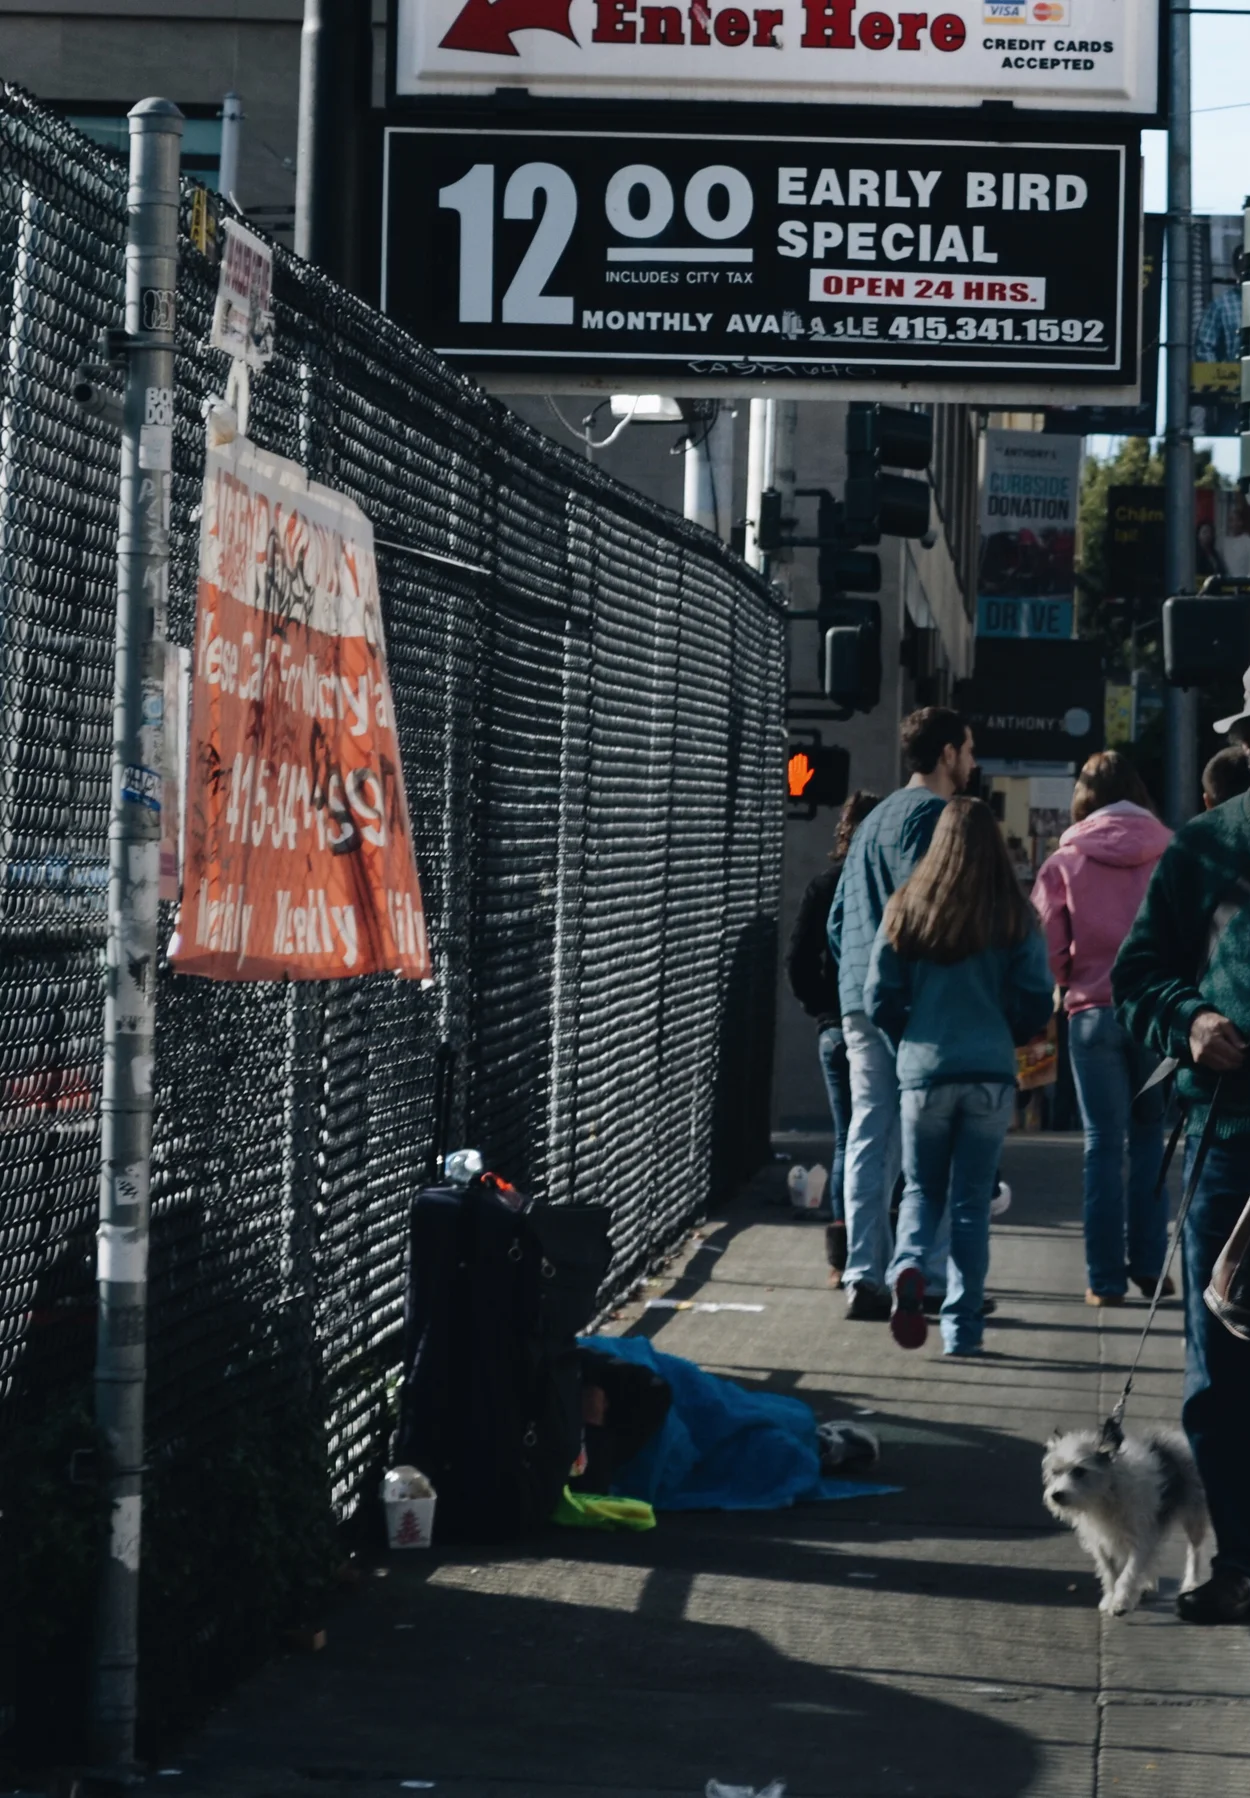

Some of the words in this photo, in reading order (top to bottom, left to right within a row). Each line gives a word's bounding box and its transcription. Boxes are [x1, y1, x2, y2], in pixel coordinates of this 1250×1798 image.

[990, 5, 1020, 17] VISA
[592, 0, 784, 48] Enter
[801, 0, 966, 52] Here
[982, 37, 1046, 52] CREDIT
[1053, 39, 1114, 53] CARDS
[1001, 56, 1095, 71] ACCEPTED
[778, 167, 943, 208] EARLY
[966, 171, 1088, 211] BIRD
[438, 162, 578, 325] 12
[777, 220, 998, 264] SPECIAL
[605, 271, 679, 284] INCLUDES
[686, 271, 720, 284] CITY
[726, 272, 753, 284] TAX
[822, 275, 904, 297] OPEN
[914, 279, 955, 299] 24
[963, 281, 1037, 303] HRS.
[582, 310, 714, 332] MONTHLY
[888, 316, 1105, 343] 415.341.1592
[989, 471, 1070, 498] CURBSIDE
[987, 494, 1070, 521] DONATION
[985, 601, 1061, 634] DRVE
